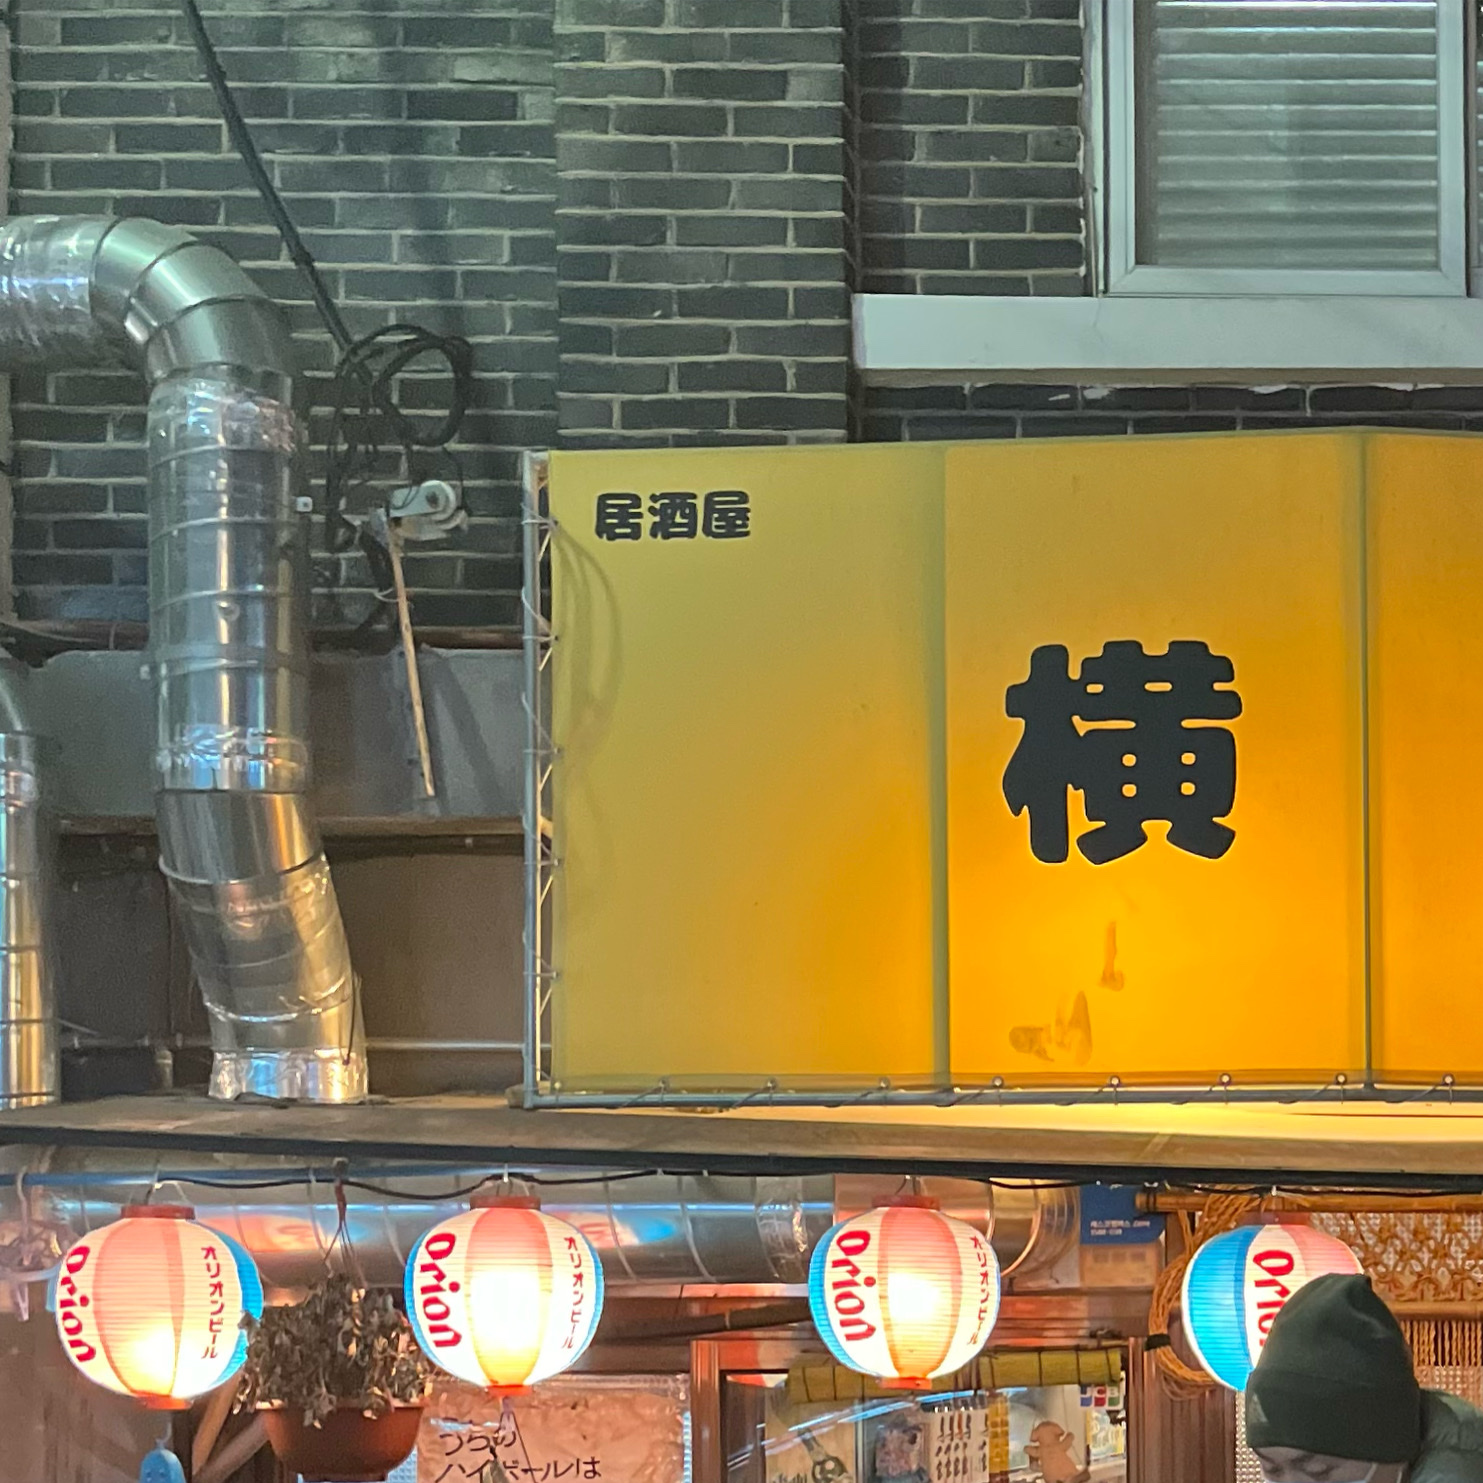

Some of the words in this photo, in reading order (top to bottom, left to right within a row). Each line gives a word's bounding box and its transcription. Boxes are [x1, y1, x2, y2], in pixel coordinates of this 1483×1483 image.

[595, 490, 751, 541] 居酒屋
[59, 1245, 96, 1363] Orion
[201, 1246, 225, 1359] オリオンビール
[420, 1232, 462, 1348] Orion
[831, 1229, 876, 1342] Orion
